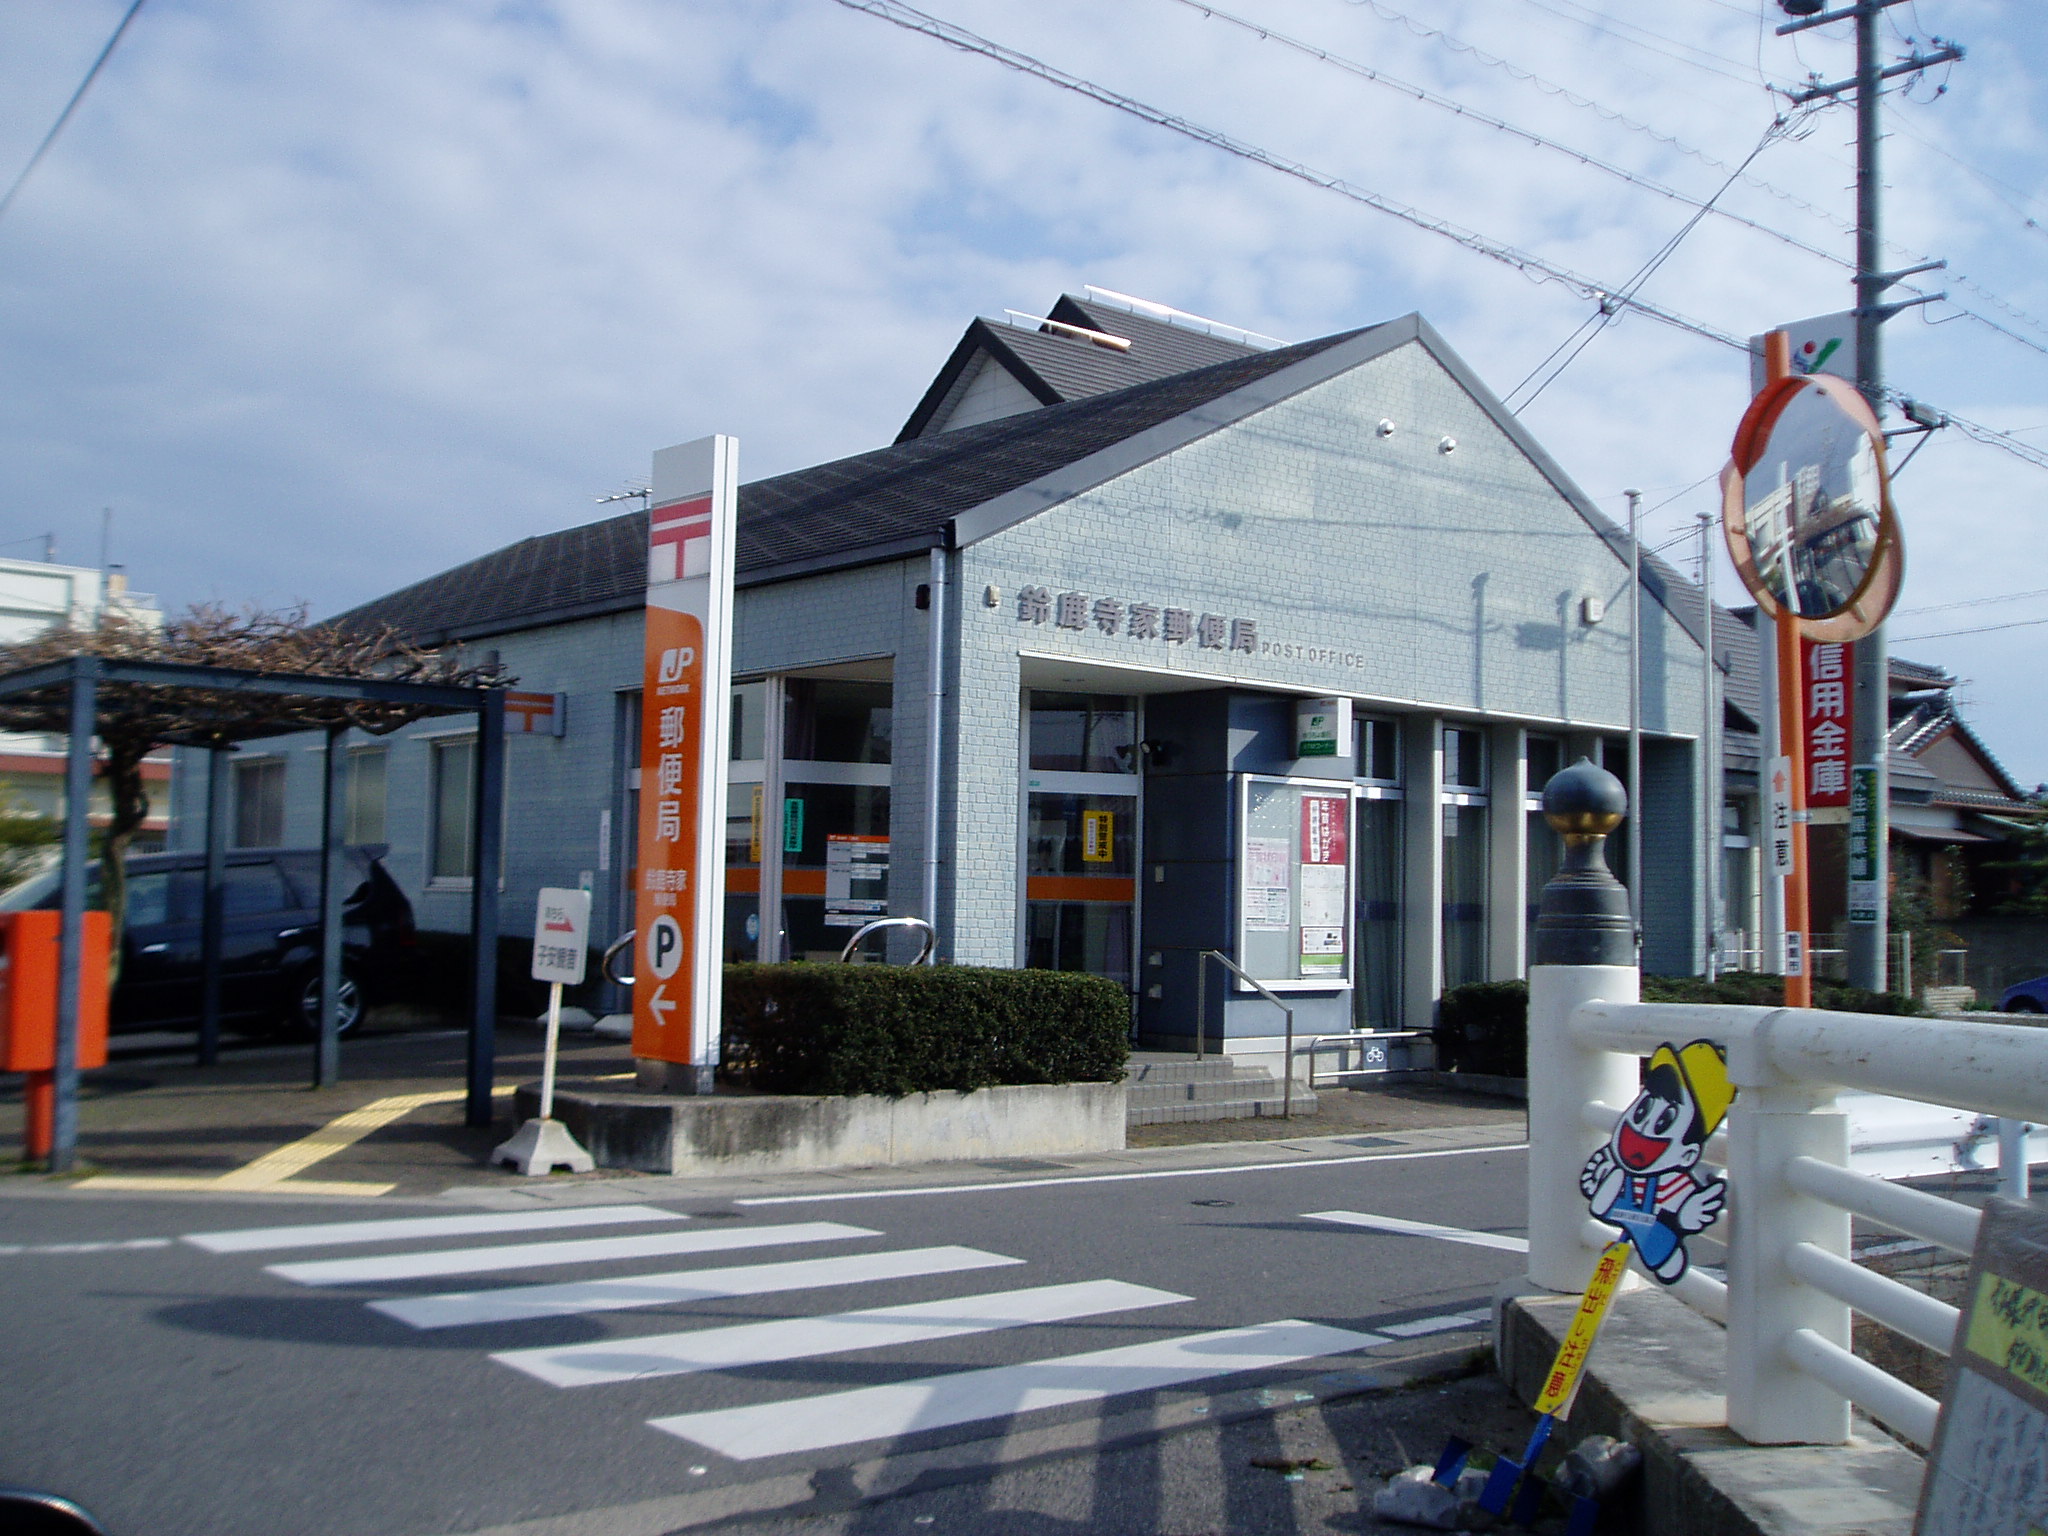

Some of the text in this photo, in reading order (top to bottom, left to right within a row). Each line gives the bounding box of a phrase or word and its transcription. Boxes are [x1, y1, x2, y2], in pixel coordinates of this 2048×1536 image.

[1018, 585, 1258, 654] 鈴鹿寺家郵便局
[1262, 641, 1364, 668] POST OFFICE
[1810, 643, 1847, 796] 信用金庫
[657, 706, 685, 842] 郵便局
[1774, 802, 1789, 867] 注意
[656, 924, 675, 968] P
